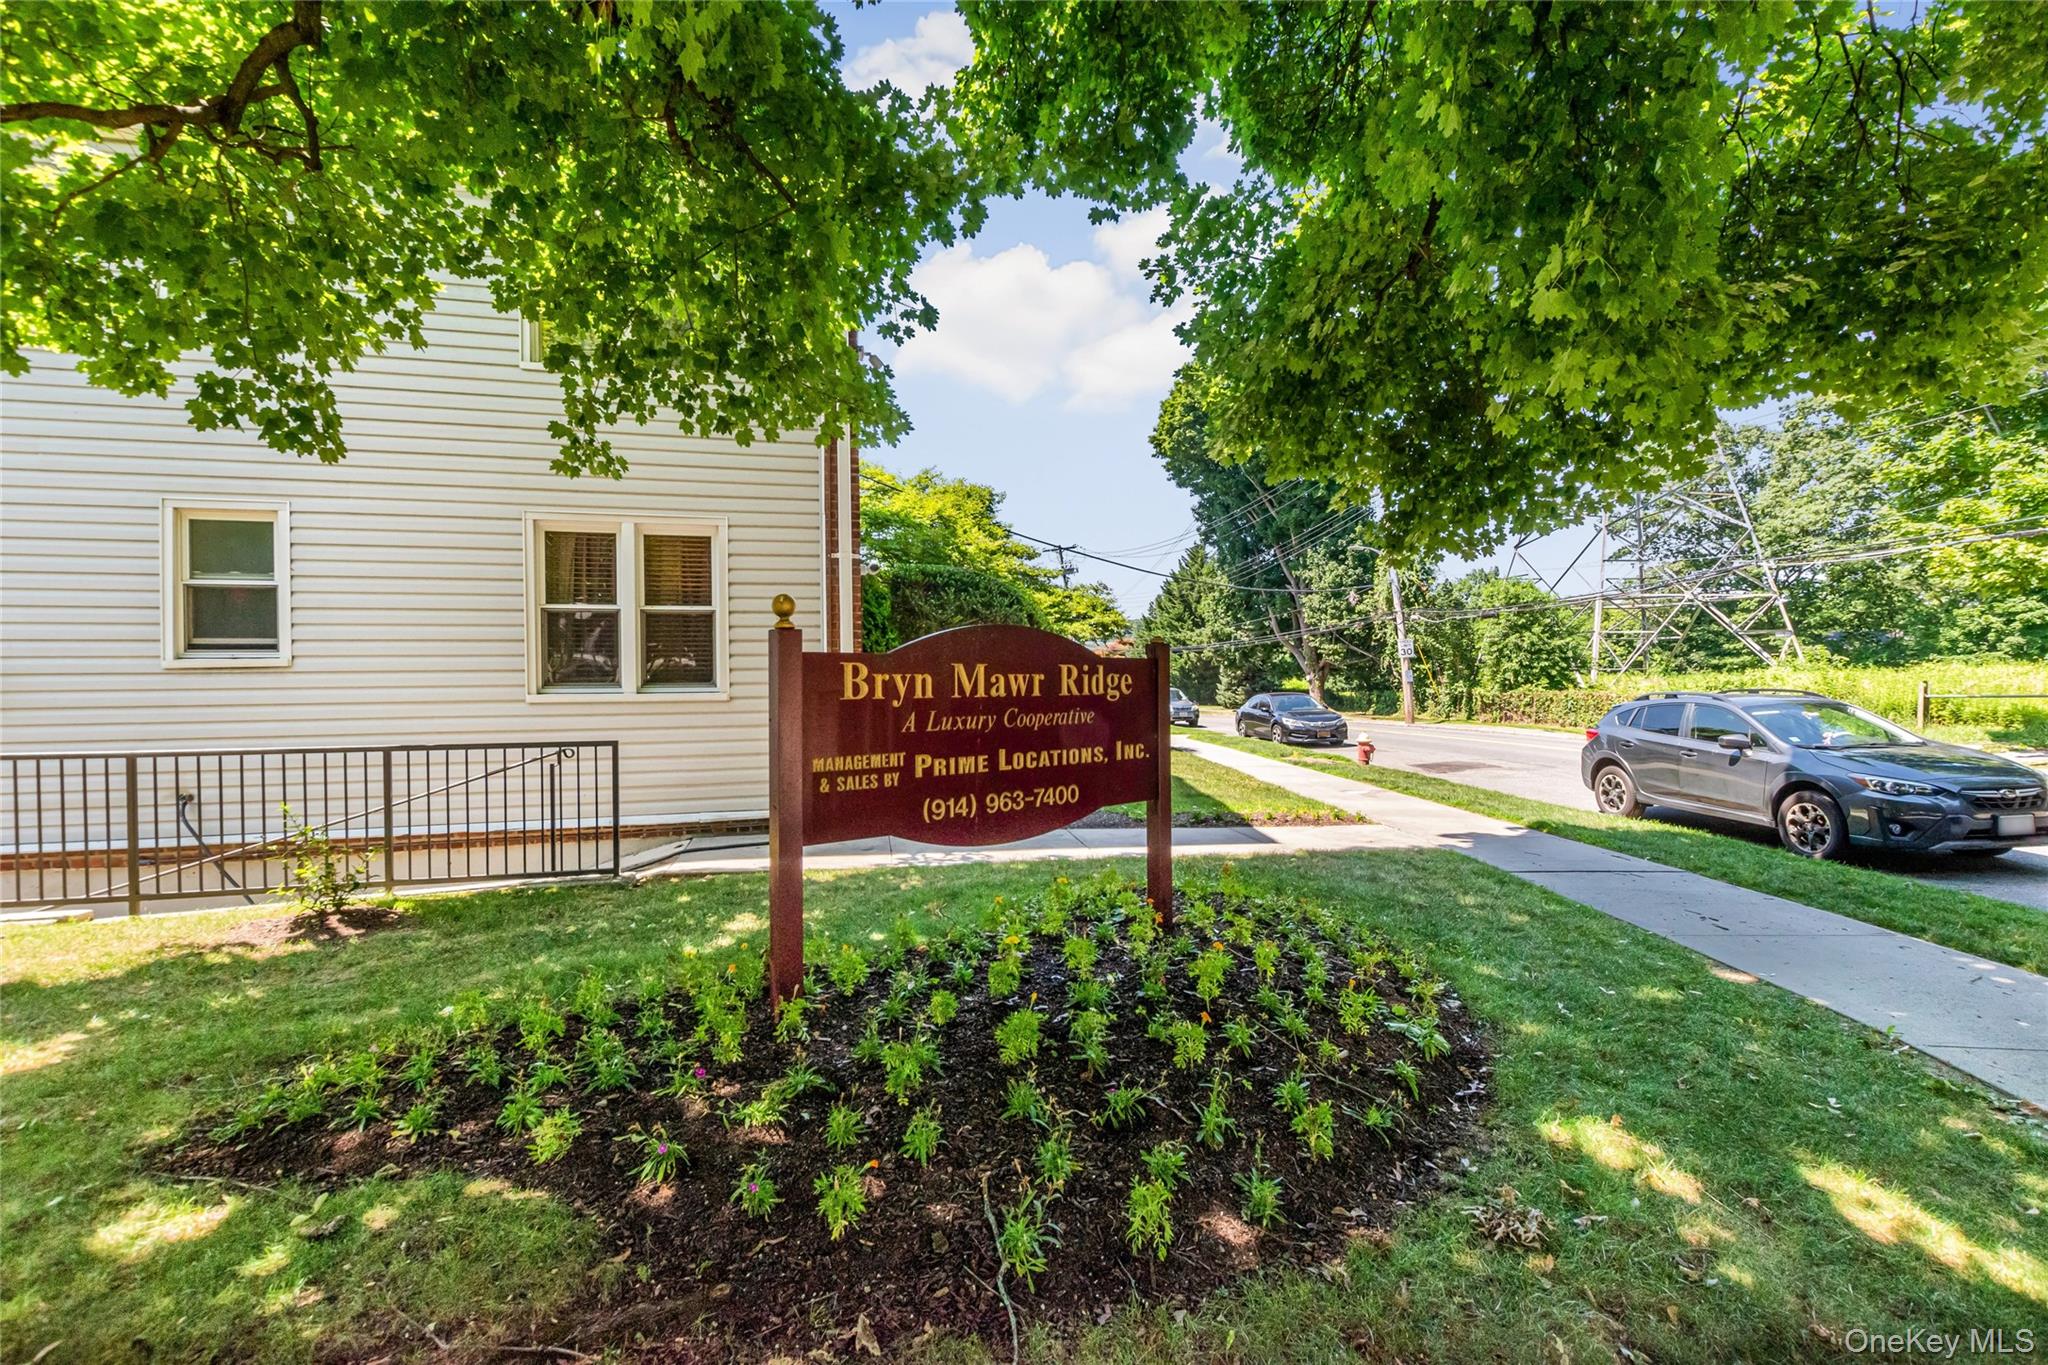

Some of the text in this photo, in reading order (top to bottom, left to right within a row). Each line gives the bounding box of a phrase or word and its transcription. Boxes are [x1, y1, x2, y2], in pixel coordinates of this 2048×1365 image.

[1401, 648, 1412, 656] 30
[840, 662, 1133, 707] Bryn Mawr Ridge
[901, 709, 1094, 733] A Luxury Cooperative
[812, 752, 906, 772] MANAGEMENT
[915, 740, 1149, 778] PRIME LOCATIONS, INC.
[819, 772, 899, 792] & SALES BY
[923, 785, 1079, 823] (914) 963-7400
